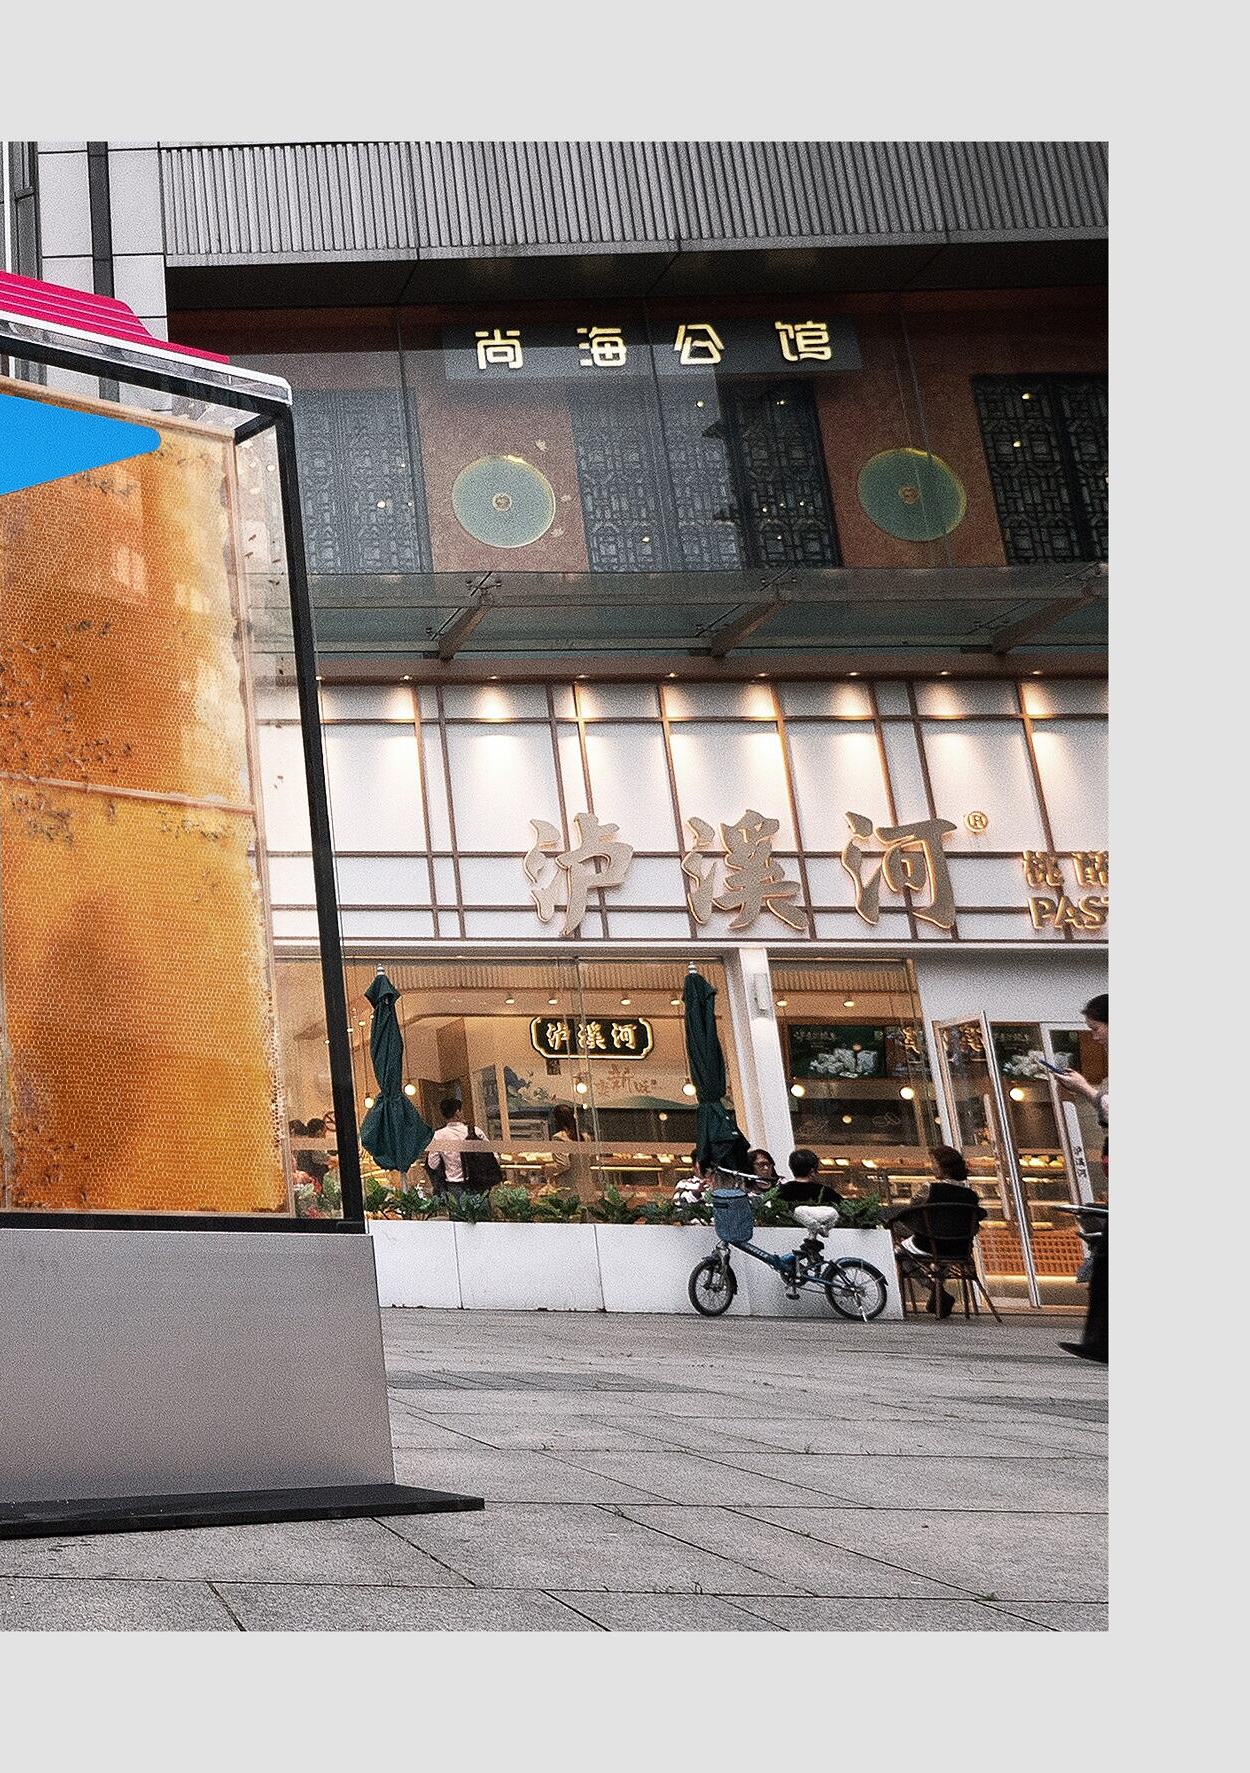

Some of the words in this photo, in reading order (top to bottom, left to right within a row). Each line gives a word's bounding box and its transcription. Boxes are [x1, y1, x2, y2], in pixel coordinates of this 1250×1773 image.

[475, 321, 832, 370] 尚海公馆
[523, 808, 958, 938] 泸溪河
[1028, 896, 1108, 930] PAS
[546, 1021, 638, 1050] 泸溪河
